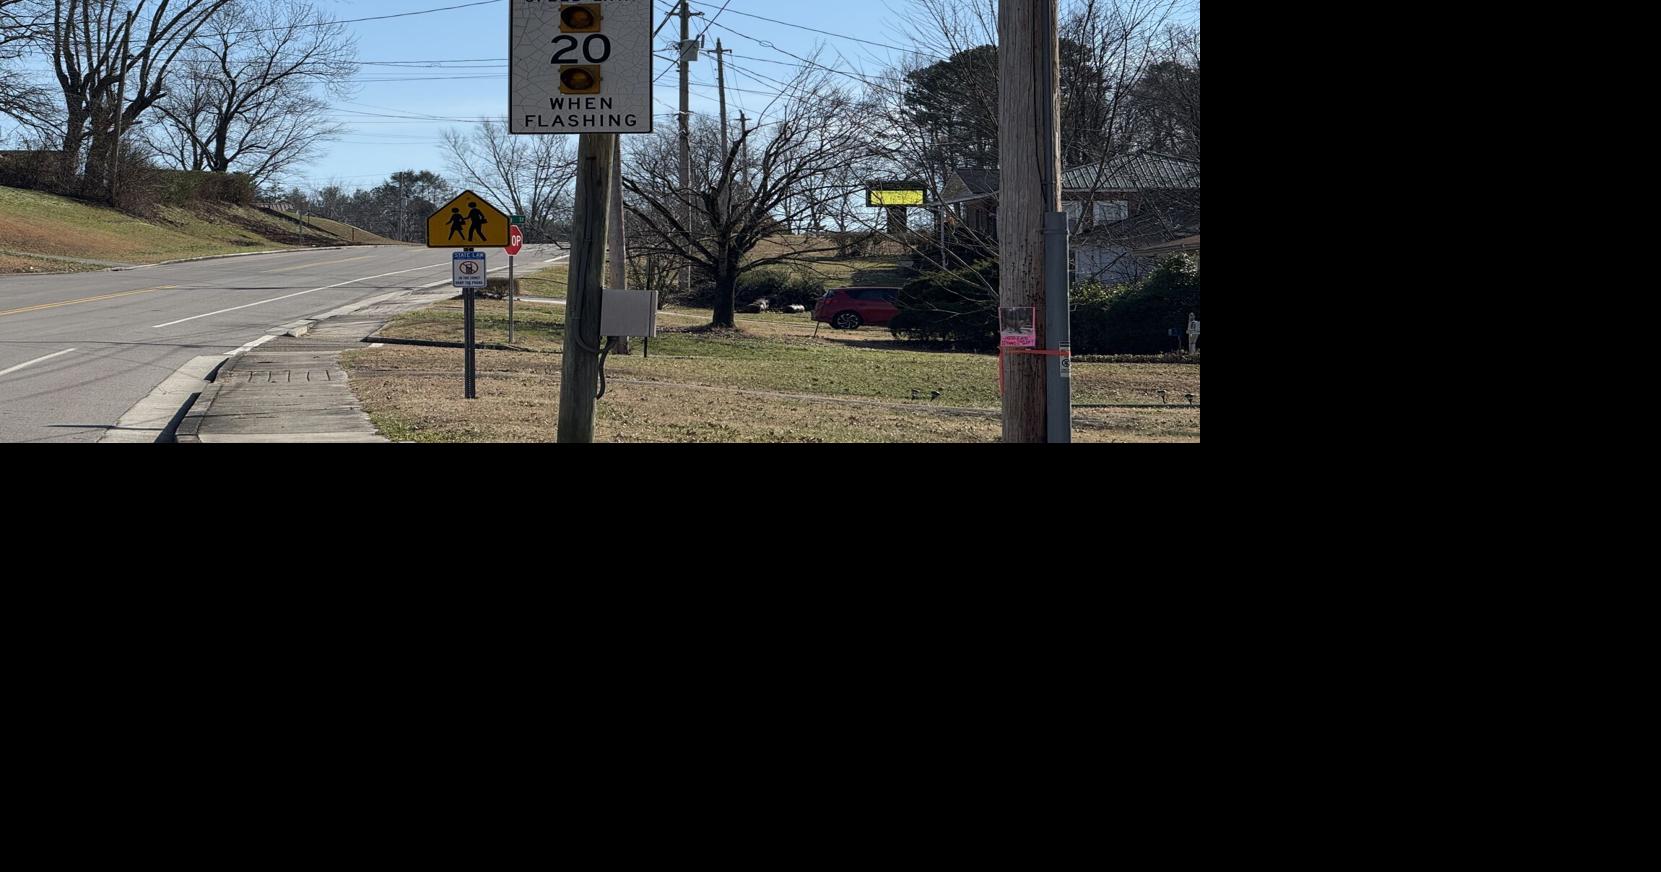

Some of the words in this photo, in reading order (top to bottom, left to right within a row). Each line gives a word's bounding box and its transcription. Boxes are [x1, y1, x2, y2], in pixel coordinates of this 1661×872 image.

[550, 33, 611, 64] 20
[549, 97, 612, 110] WHEN
[525, 114, 637, 127] FLASHING
[512, 235, 522, 246] OP
